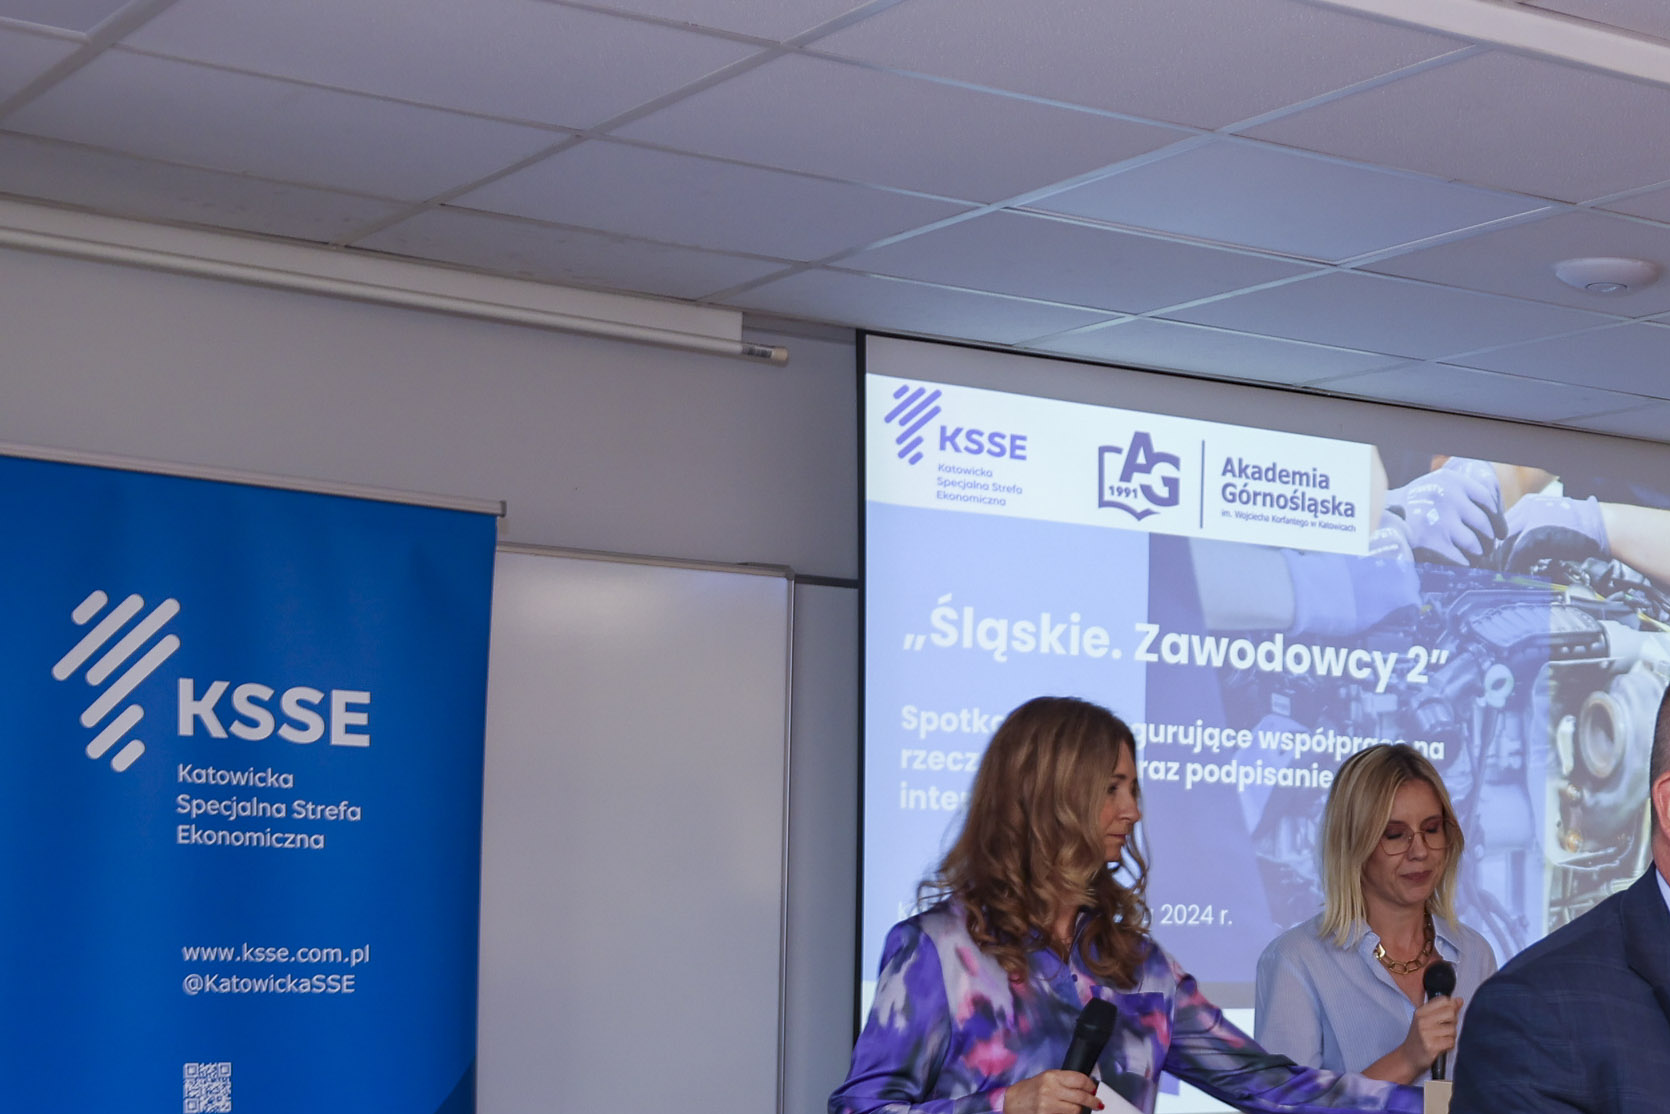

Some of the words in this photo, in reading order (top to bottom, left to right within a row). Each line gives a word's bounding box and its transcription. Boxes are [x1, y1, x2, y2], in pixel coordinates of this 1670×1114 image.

[939, 424, 1028, 461] KSSE
[937, 463, 993, 478] Katowicka
[1221, 456, 1331, 490] Akademia
[936, 476, 990, 491] Specjalna
[991, 481, 1023, 495] Strefa
[936, 490, 1007, 506] Ekonomiczna
[1108, 484, 1138, 499] 1991
[1221, 482, 1356, 519] Górnośląska
[1221, 509, 1233, 518] im.
[1234, 510, 1270, 523] Wojciecha
[1271, 515, 1309, 528] Korfantego
[1310, 519, 1318, 528] w
[1318, 520, 1357, 533] Katowicach
[1133, 622, 1400, 693] Zawodowcy
[177, 677, 371, 747] KSSE
[1134, 718, 1253, 754] gurujące
[1413, 739, 1445, 760] na
[177, 763, 294, 789] Katowicka
[1139, 758, 1180, 782] raz
[1186, 758, 1333, 792] podpisanie
[176, 793, 287, 821] Specjalna
[292, 799, 362, 821] Strefa
[176, 824, 326, 850] Ekonomiczna
[1160, 903, 1214, 925] 2024
[1220, 907, 1233, 925] r.
[181, 942, 371, 968] www.ksse.com.pl
[182, 973, 356, 996] @KatowickaSSE
